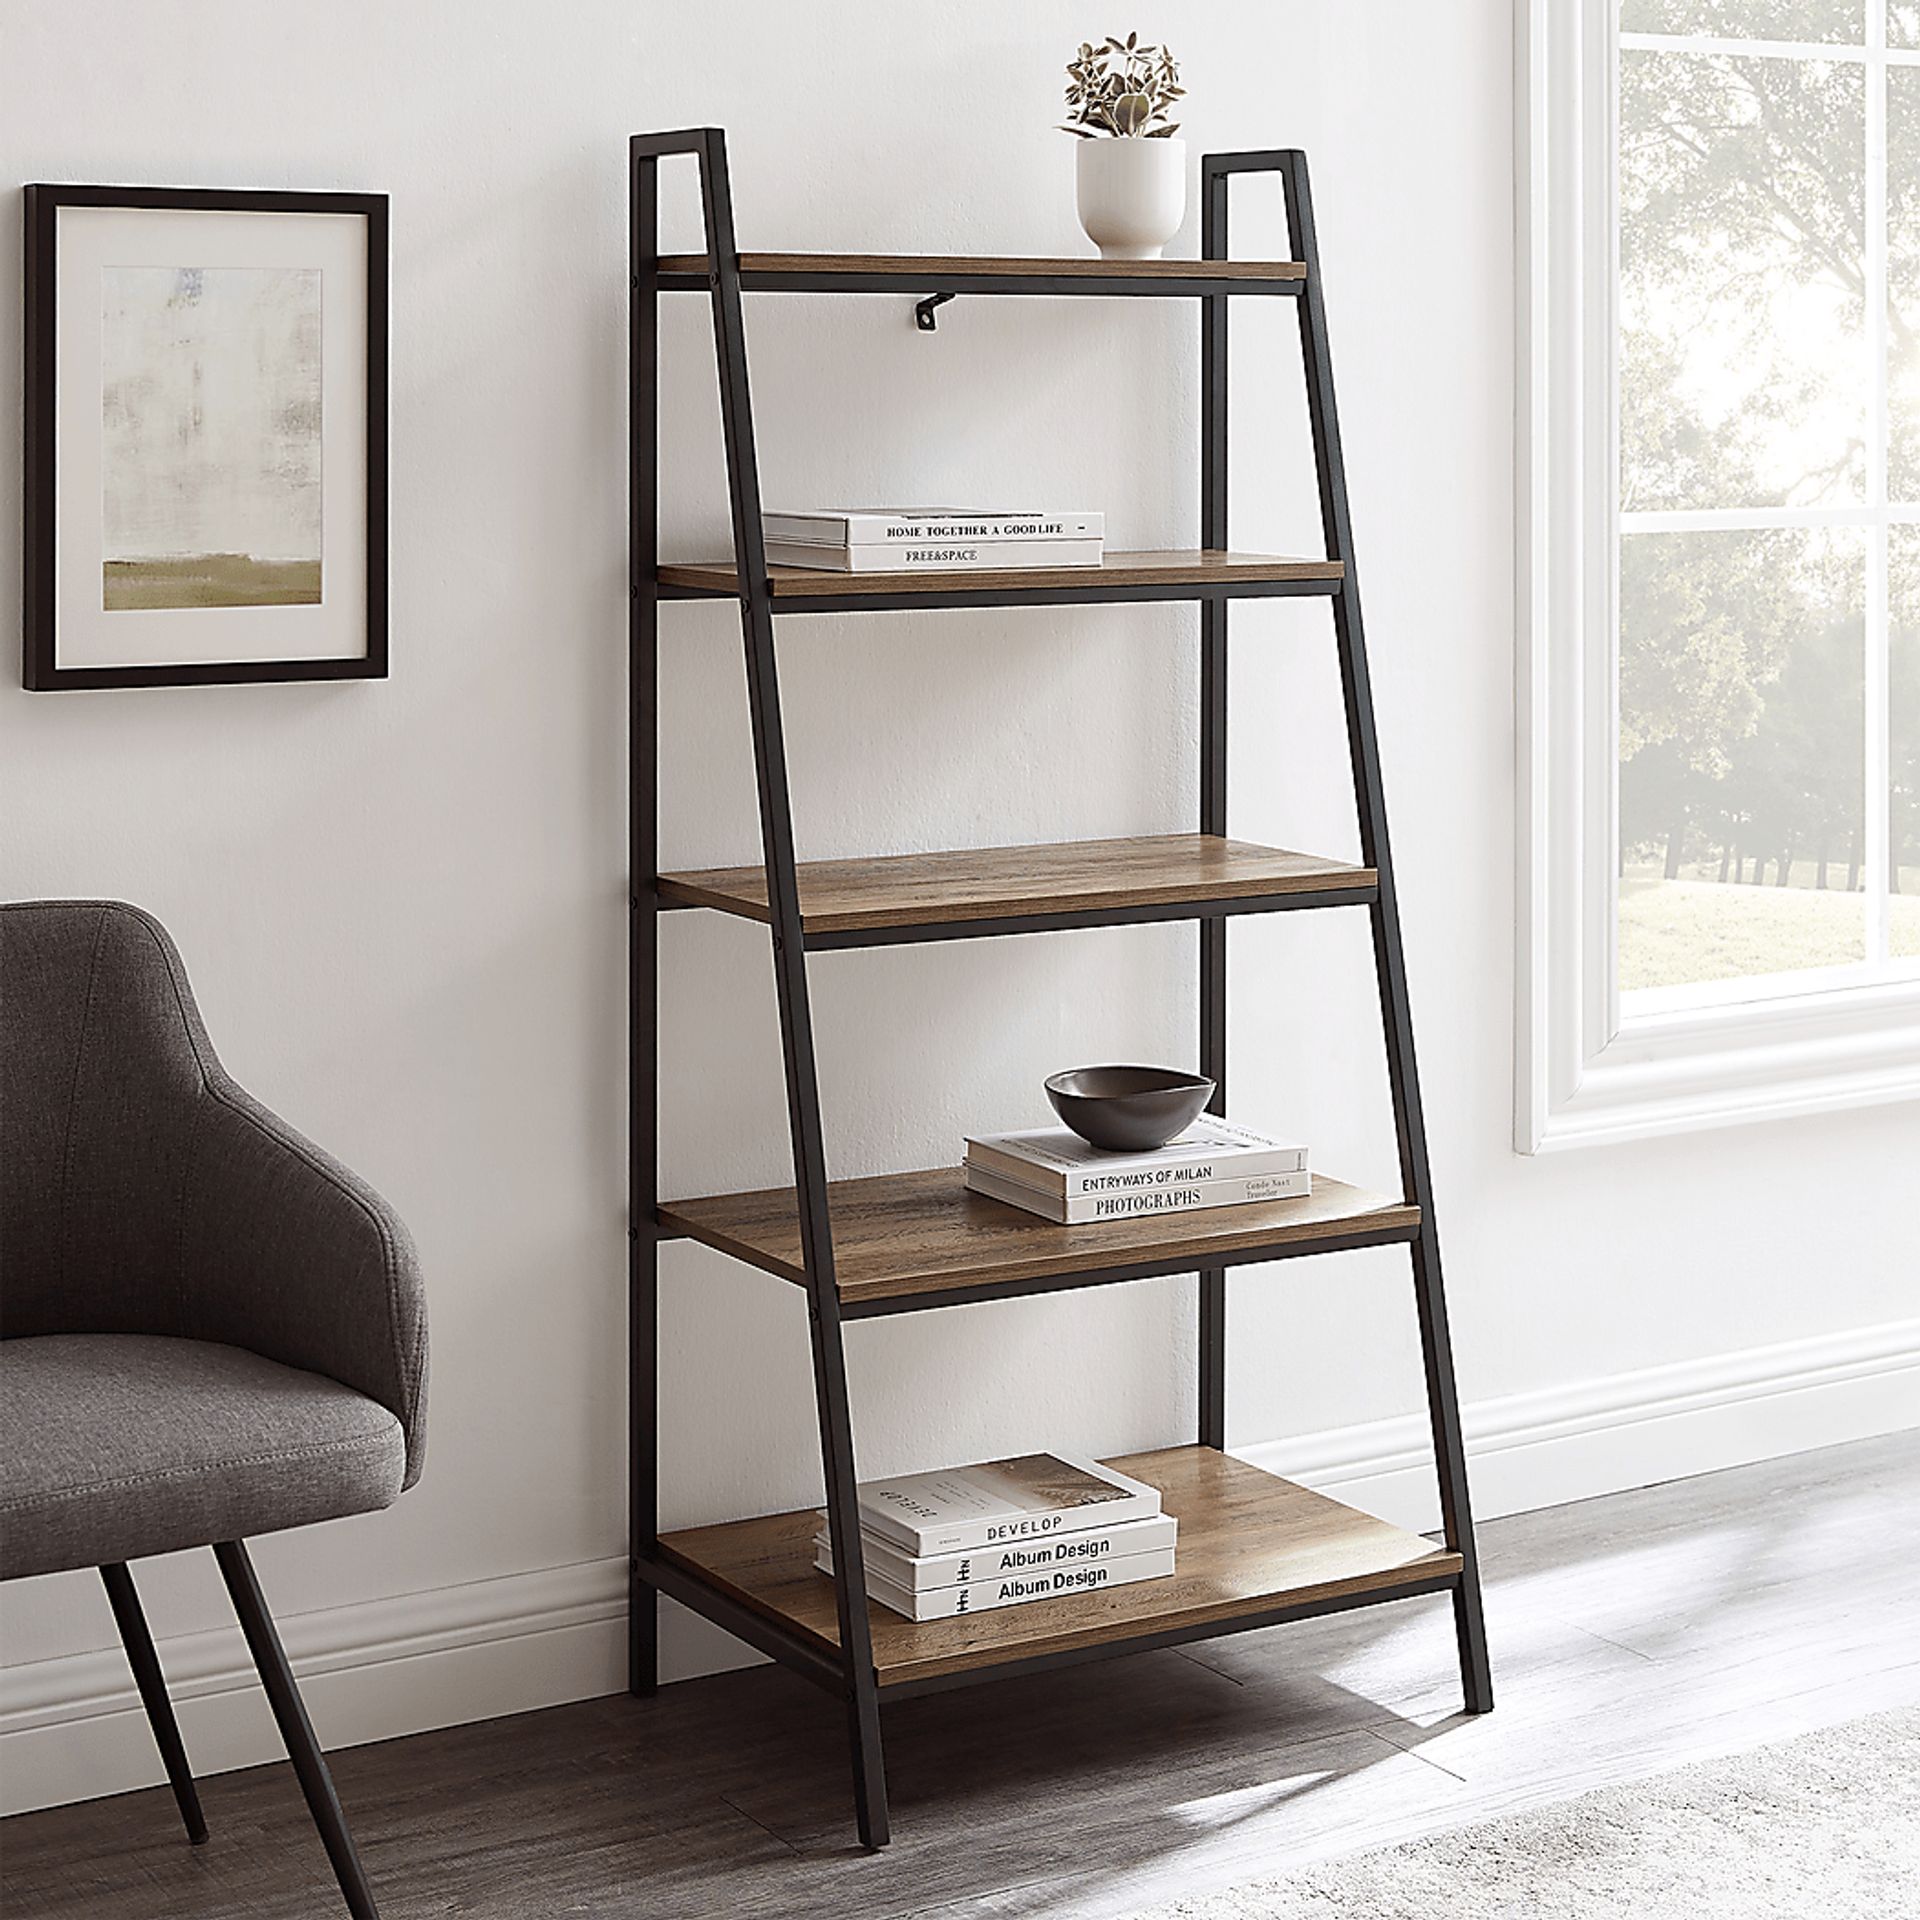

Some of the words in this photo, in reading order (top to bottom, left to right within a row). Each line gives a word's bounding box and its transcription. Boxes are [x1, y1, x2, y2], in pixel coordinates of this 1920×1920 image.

[887, 526, 921, 537] HOME
[926, 525, 987, 537] TOGETHER
[991, 526, 1000, 535] A
[1004, 525, 1036, 535] GOOD
[1038, 524, 1063, 534] LIFE
[906, 550, 978, 562] FREE&SPACE
[1082, 1172, 1153, 1191] ENTRYWAYS
[1156, 1170, 1172, 1184] OF
[1174, 1166, 1212, 1181] MILAN
[1096, 1189, 1201, 1215] PHOTOGRAPHS
[987, 1516, 1062, 1540] DEVELOP
[1000, 1551, 1052, 1570] Album
[1055, 1540, 1110, 1560] Design
[998, 1581, 1050, 1599] Album
[1053, 1569, 1107, 1589] Design
